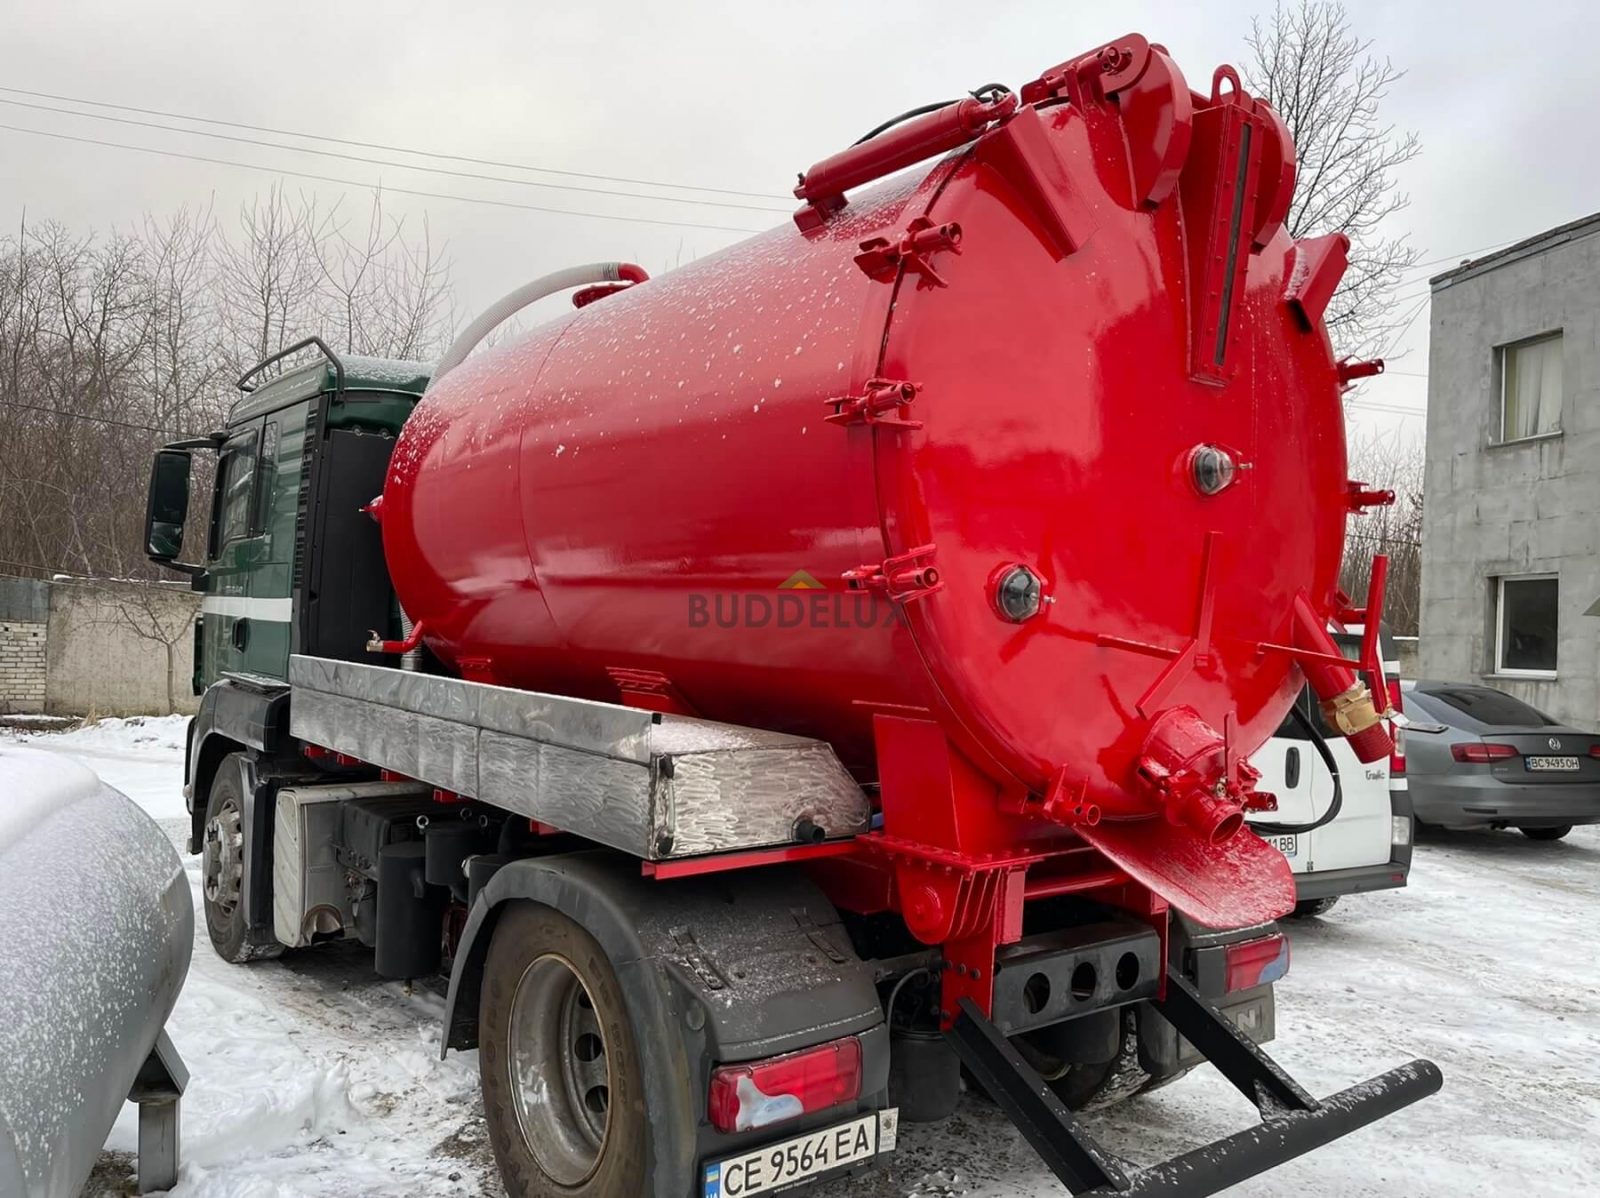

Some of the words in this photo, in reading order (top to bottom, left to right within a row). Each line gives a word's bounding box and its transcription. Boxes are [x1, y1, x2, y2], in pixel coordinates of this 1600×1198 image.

[1532, 758, 1544, 768] BC
[1545, 758, 1565, 768] 9495
[724, 1156, 762, 1196] CE
[770, 1134, 828, 1182] 9564
[835, 1123, 869, 1161] EA
